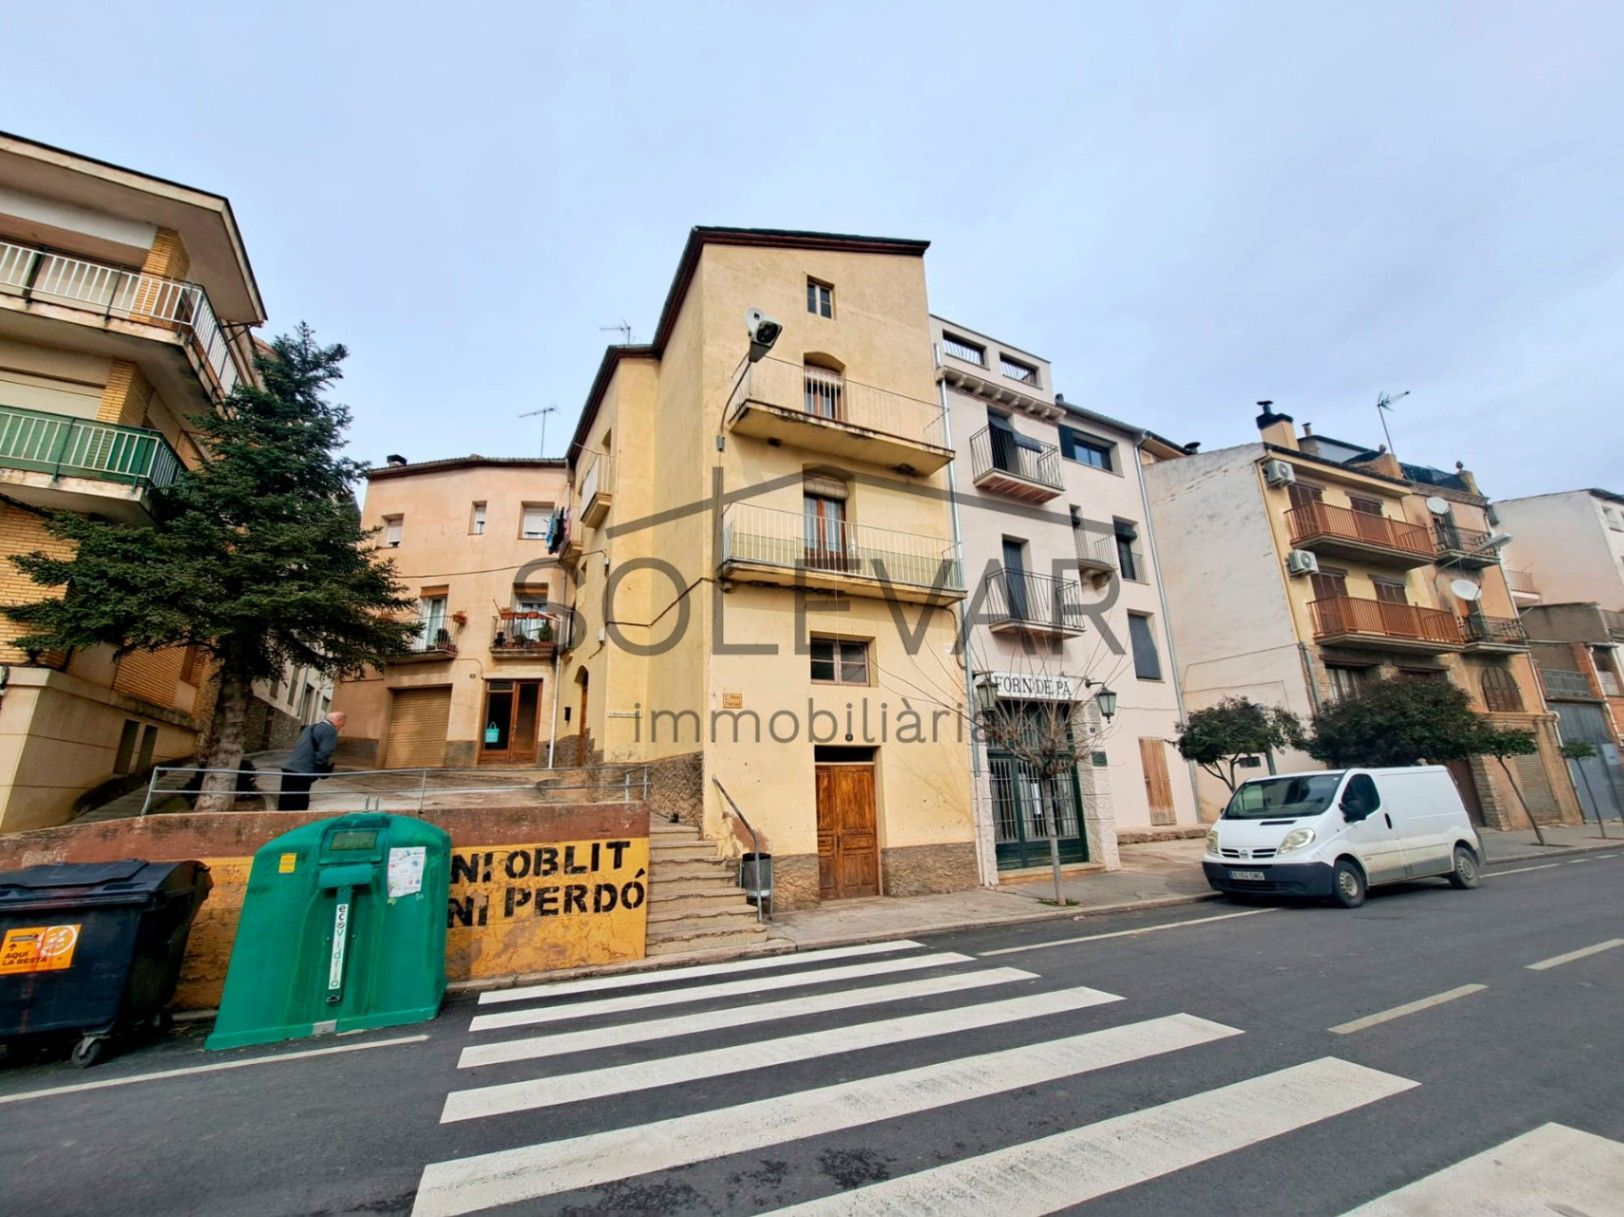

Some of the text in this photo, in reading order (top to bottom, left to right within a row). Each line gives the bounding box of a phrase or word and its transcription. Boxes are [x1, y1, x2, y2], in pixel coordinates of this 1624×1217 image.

[993, 676, 1033, 694] FORN
[1035, 679, 1054, 695] DE
[450, 853, 493, 883] NI
[505, 841, 631, 879] OBLIT
[447, 868, 646, 928] NI PERDÓ
